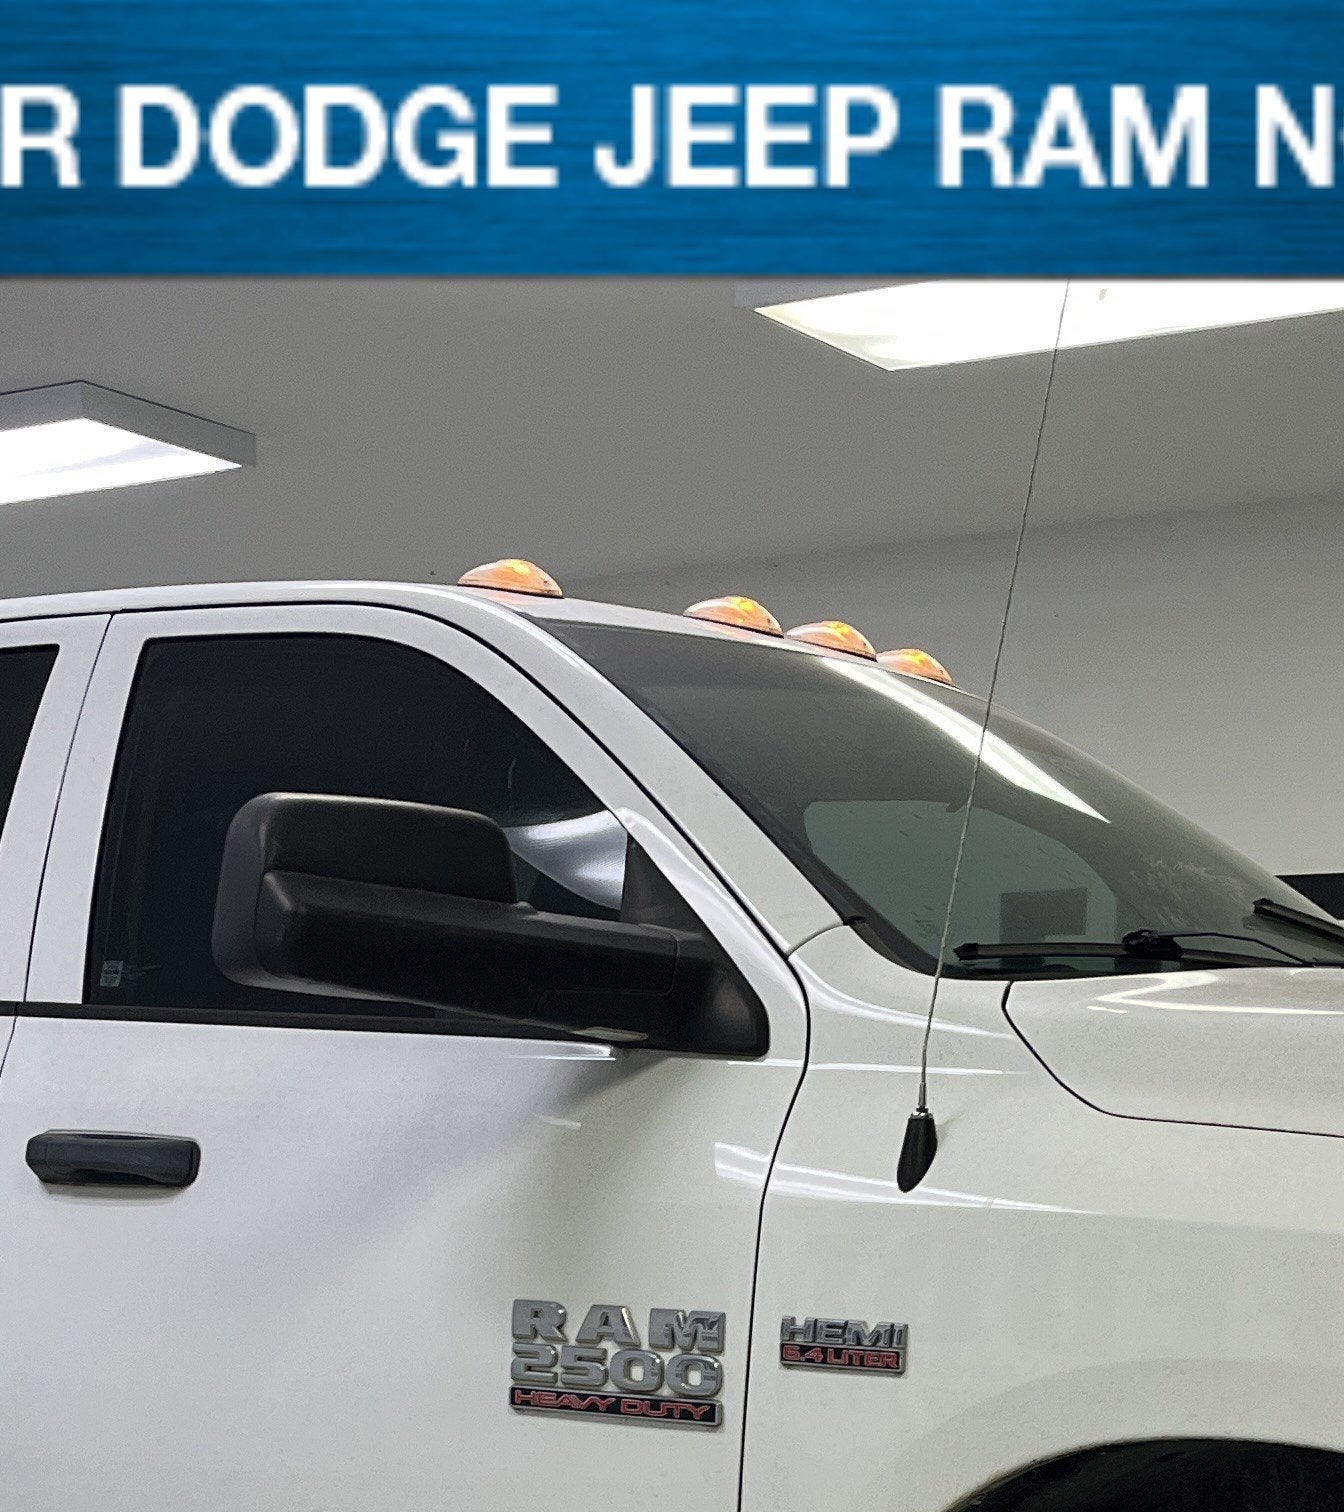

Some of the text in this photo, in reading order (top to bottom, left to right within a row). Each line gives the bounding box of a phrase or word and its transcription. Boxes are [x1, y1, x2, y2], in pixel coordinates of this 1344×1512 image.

[511, 1299, 726, 1353] RAM
[780, 1315, 908, 1349] HEMI
[511, 1342, 724, 1397] 2500
[826, 1348, 898, 1368] LITER
[514, 1388, 711, 1420] HEAVY DUTY
